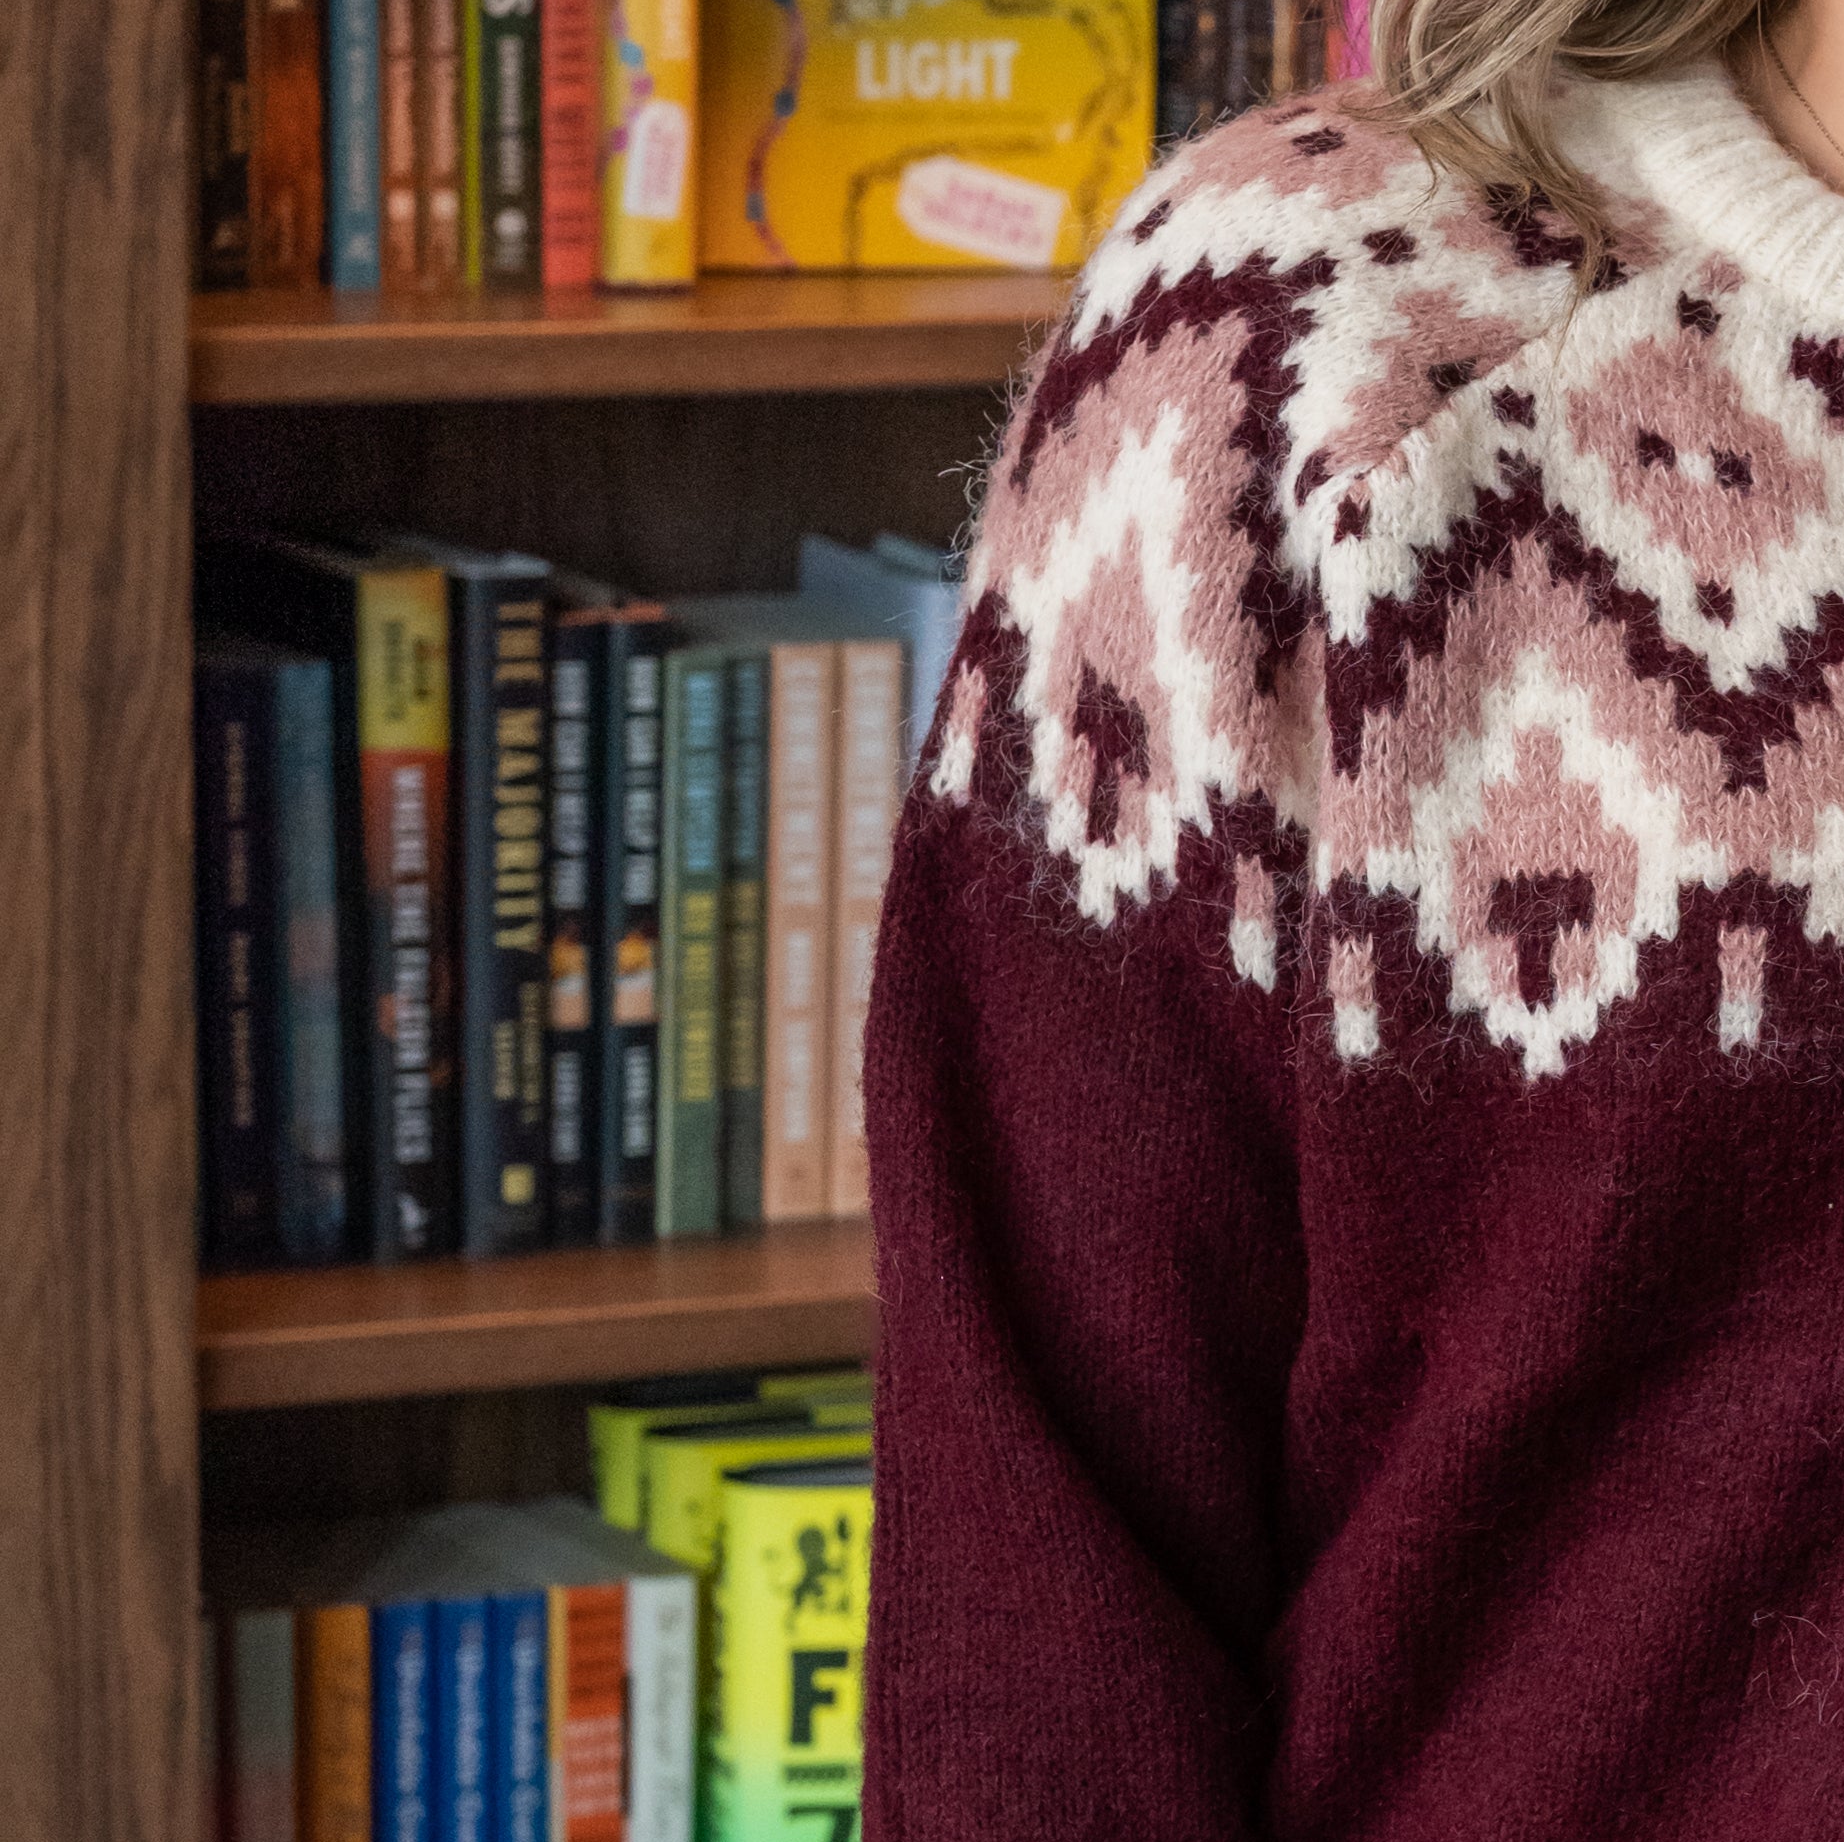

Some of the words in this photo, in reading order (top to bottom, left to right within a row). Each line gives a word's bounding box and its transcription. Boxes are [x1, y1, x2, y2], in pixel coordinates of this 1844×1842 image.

[855, 40, 1020, 100] LIGHT
[495, 602, 541, 687] THE
[495, 708, 541, 953] MAJORITY
